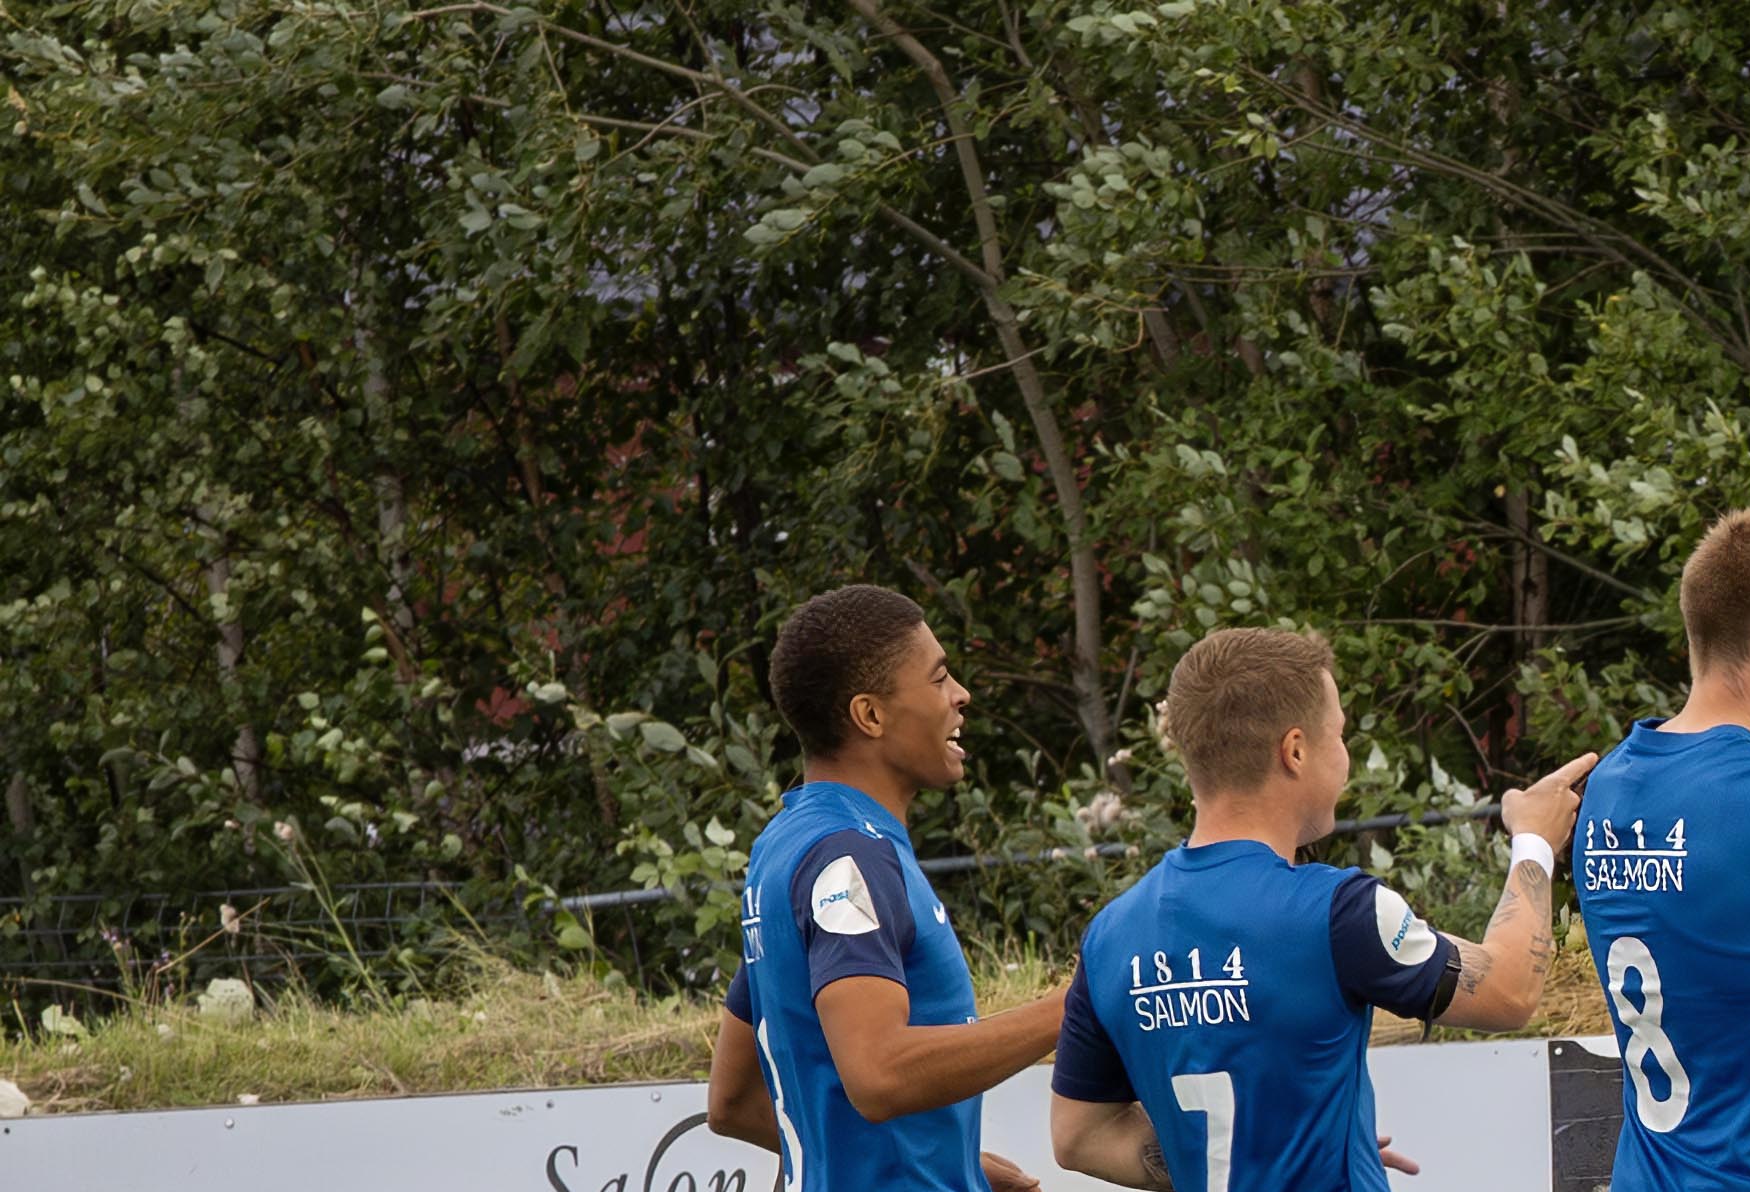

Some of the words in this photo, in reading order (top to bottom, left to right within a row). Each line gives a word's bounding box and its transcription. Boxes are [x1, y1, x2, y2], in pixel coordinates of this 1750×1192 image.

[1585, 858, 1683, 892] SALMON
[1134, 987, 1250, 1031] SALMON
[1607, 936, 1690, 1132] 8
